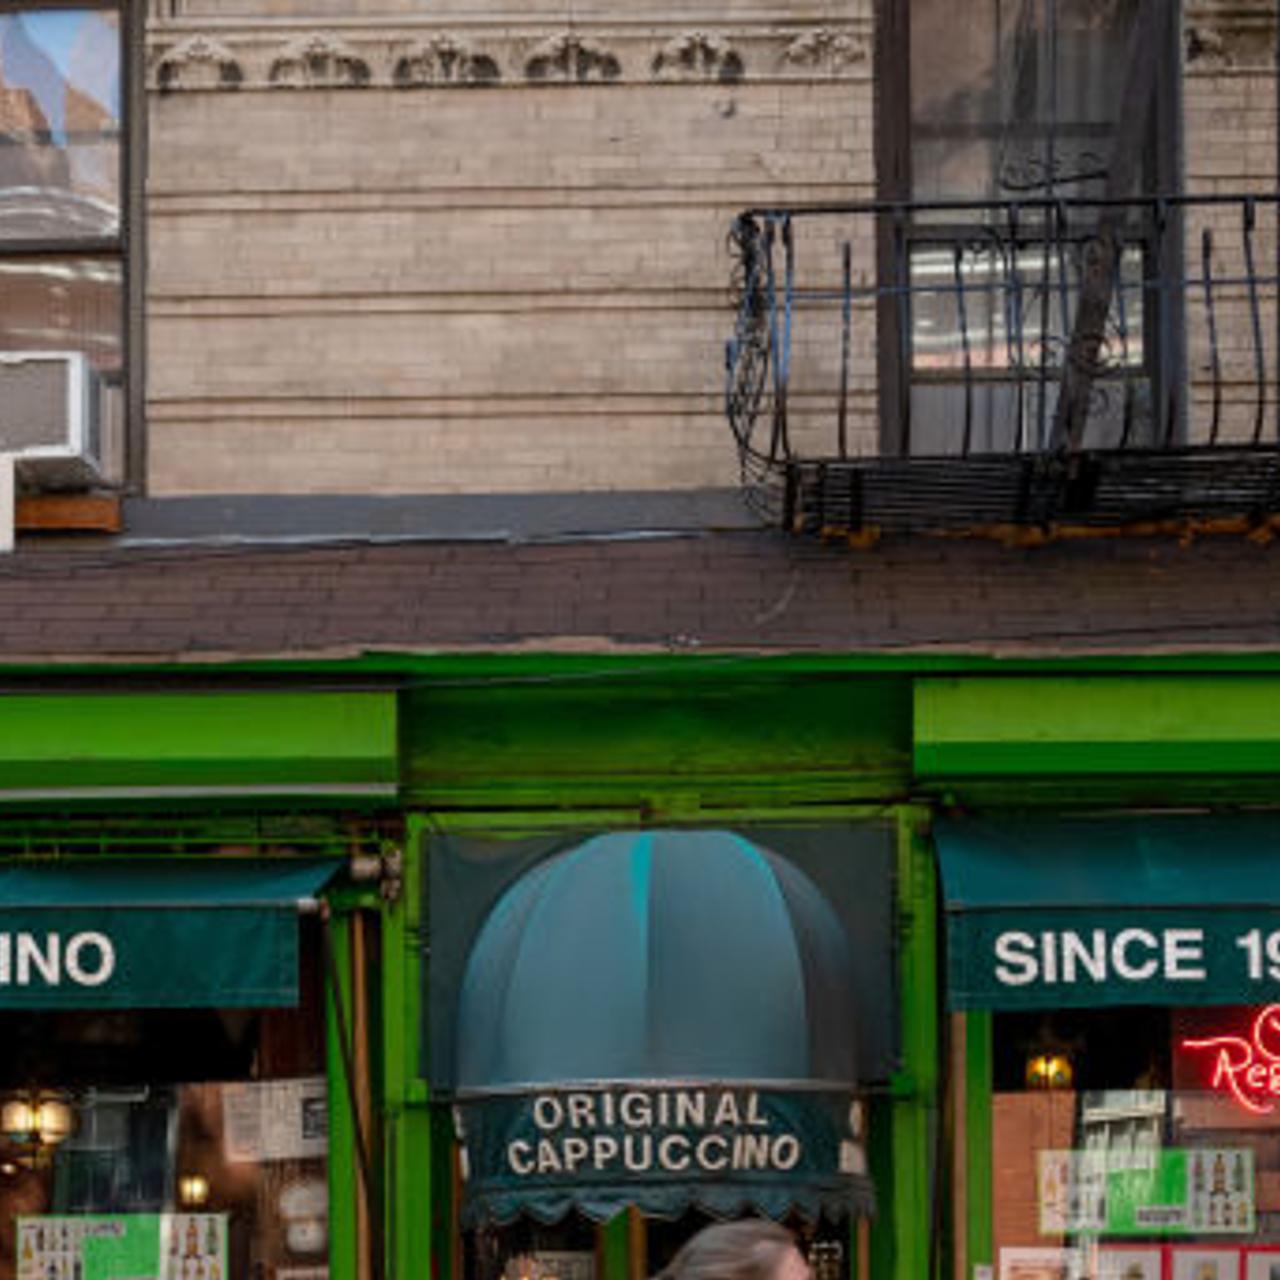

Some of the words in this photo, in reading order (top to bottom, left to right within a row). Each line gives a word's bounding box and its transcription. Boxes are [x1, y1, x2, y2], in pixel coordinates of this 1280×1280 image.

[993, 929, 1206, 985] SINCE
[532, 1091, 769, 1131] ORIGINAL
[507, 1133, 803, 1175] CAPPUCCINO
